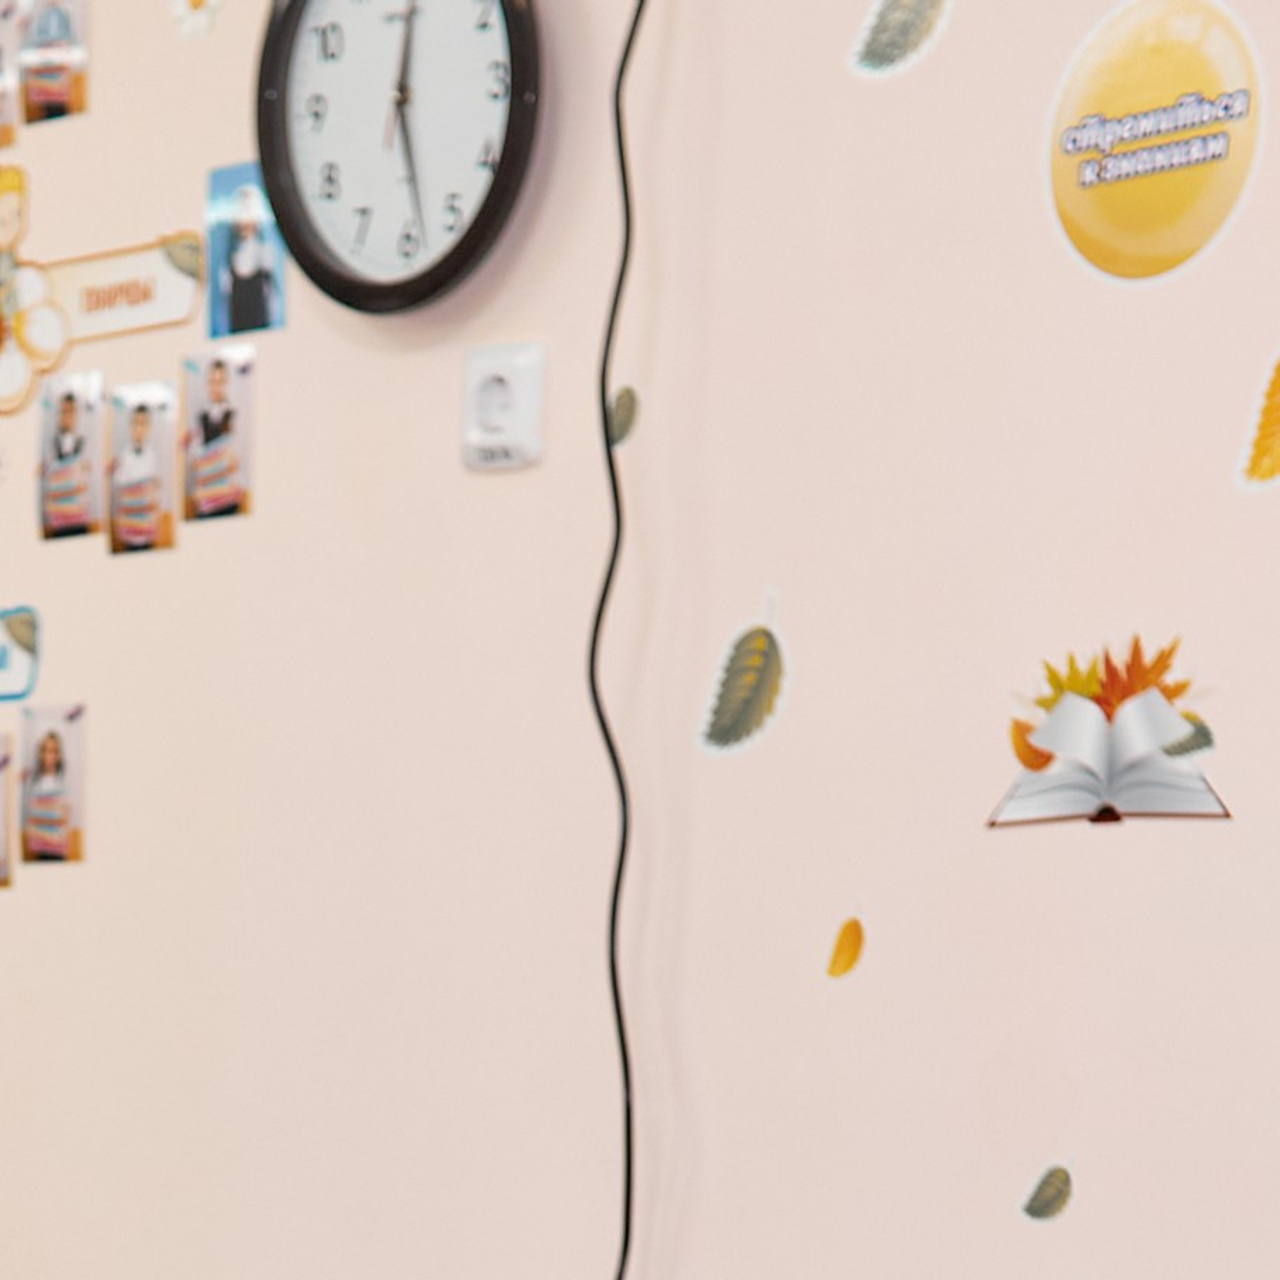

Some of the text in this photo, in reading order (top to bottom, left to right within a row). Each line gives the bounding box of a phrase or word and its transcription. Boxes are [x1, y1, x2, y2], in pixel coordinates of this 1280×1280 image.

[312, 20, 345, 62] 10
[487, 60, 510, 100] 3
[305, 94, 328, 132] 9
[476, 136, 499, 174] 4
[320, 161, 342, 200] 8
[352, 205, 373, 254] 7
[444, 192, 465, 233] 5
[395, 217, 420, 259] 6
